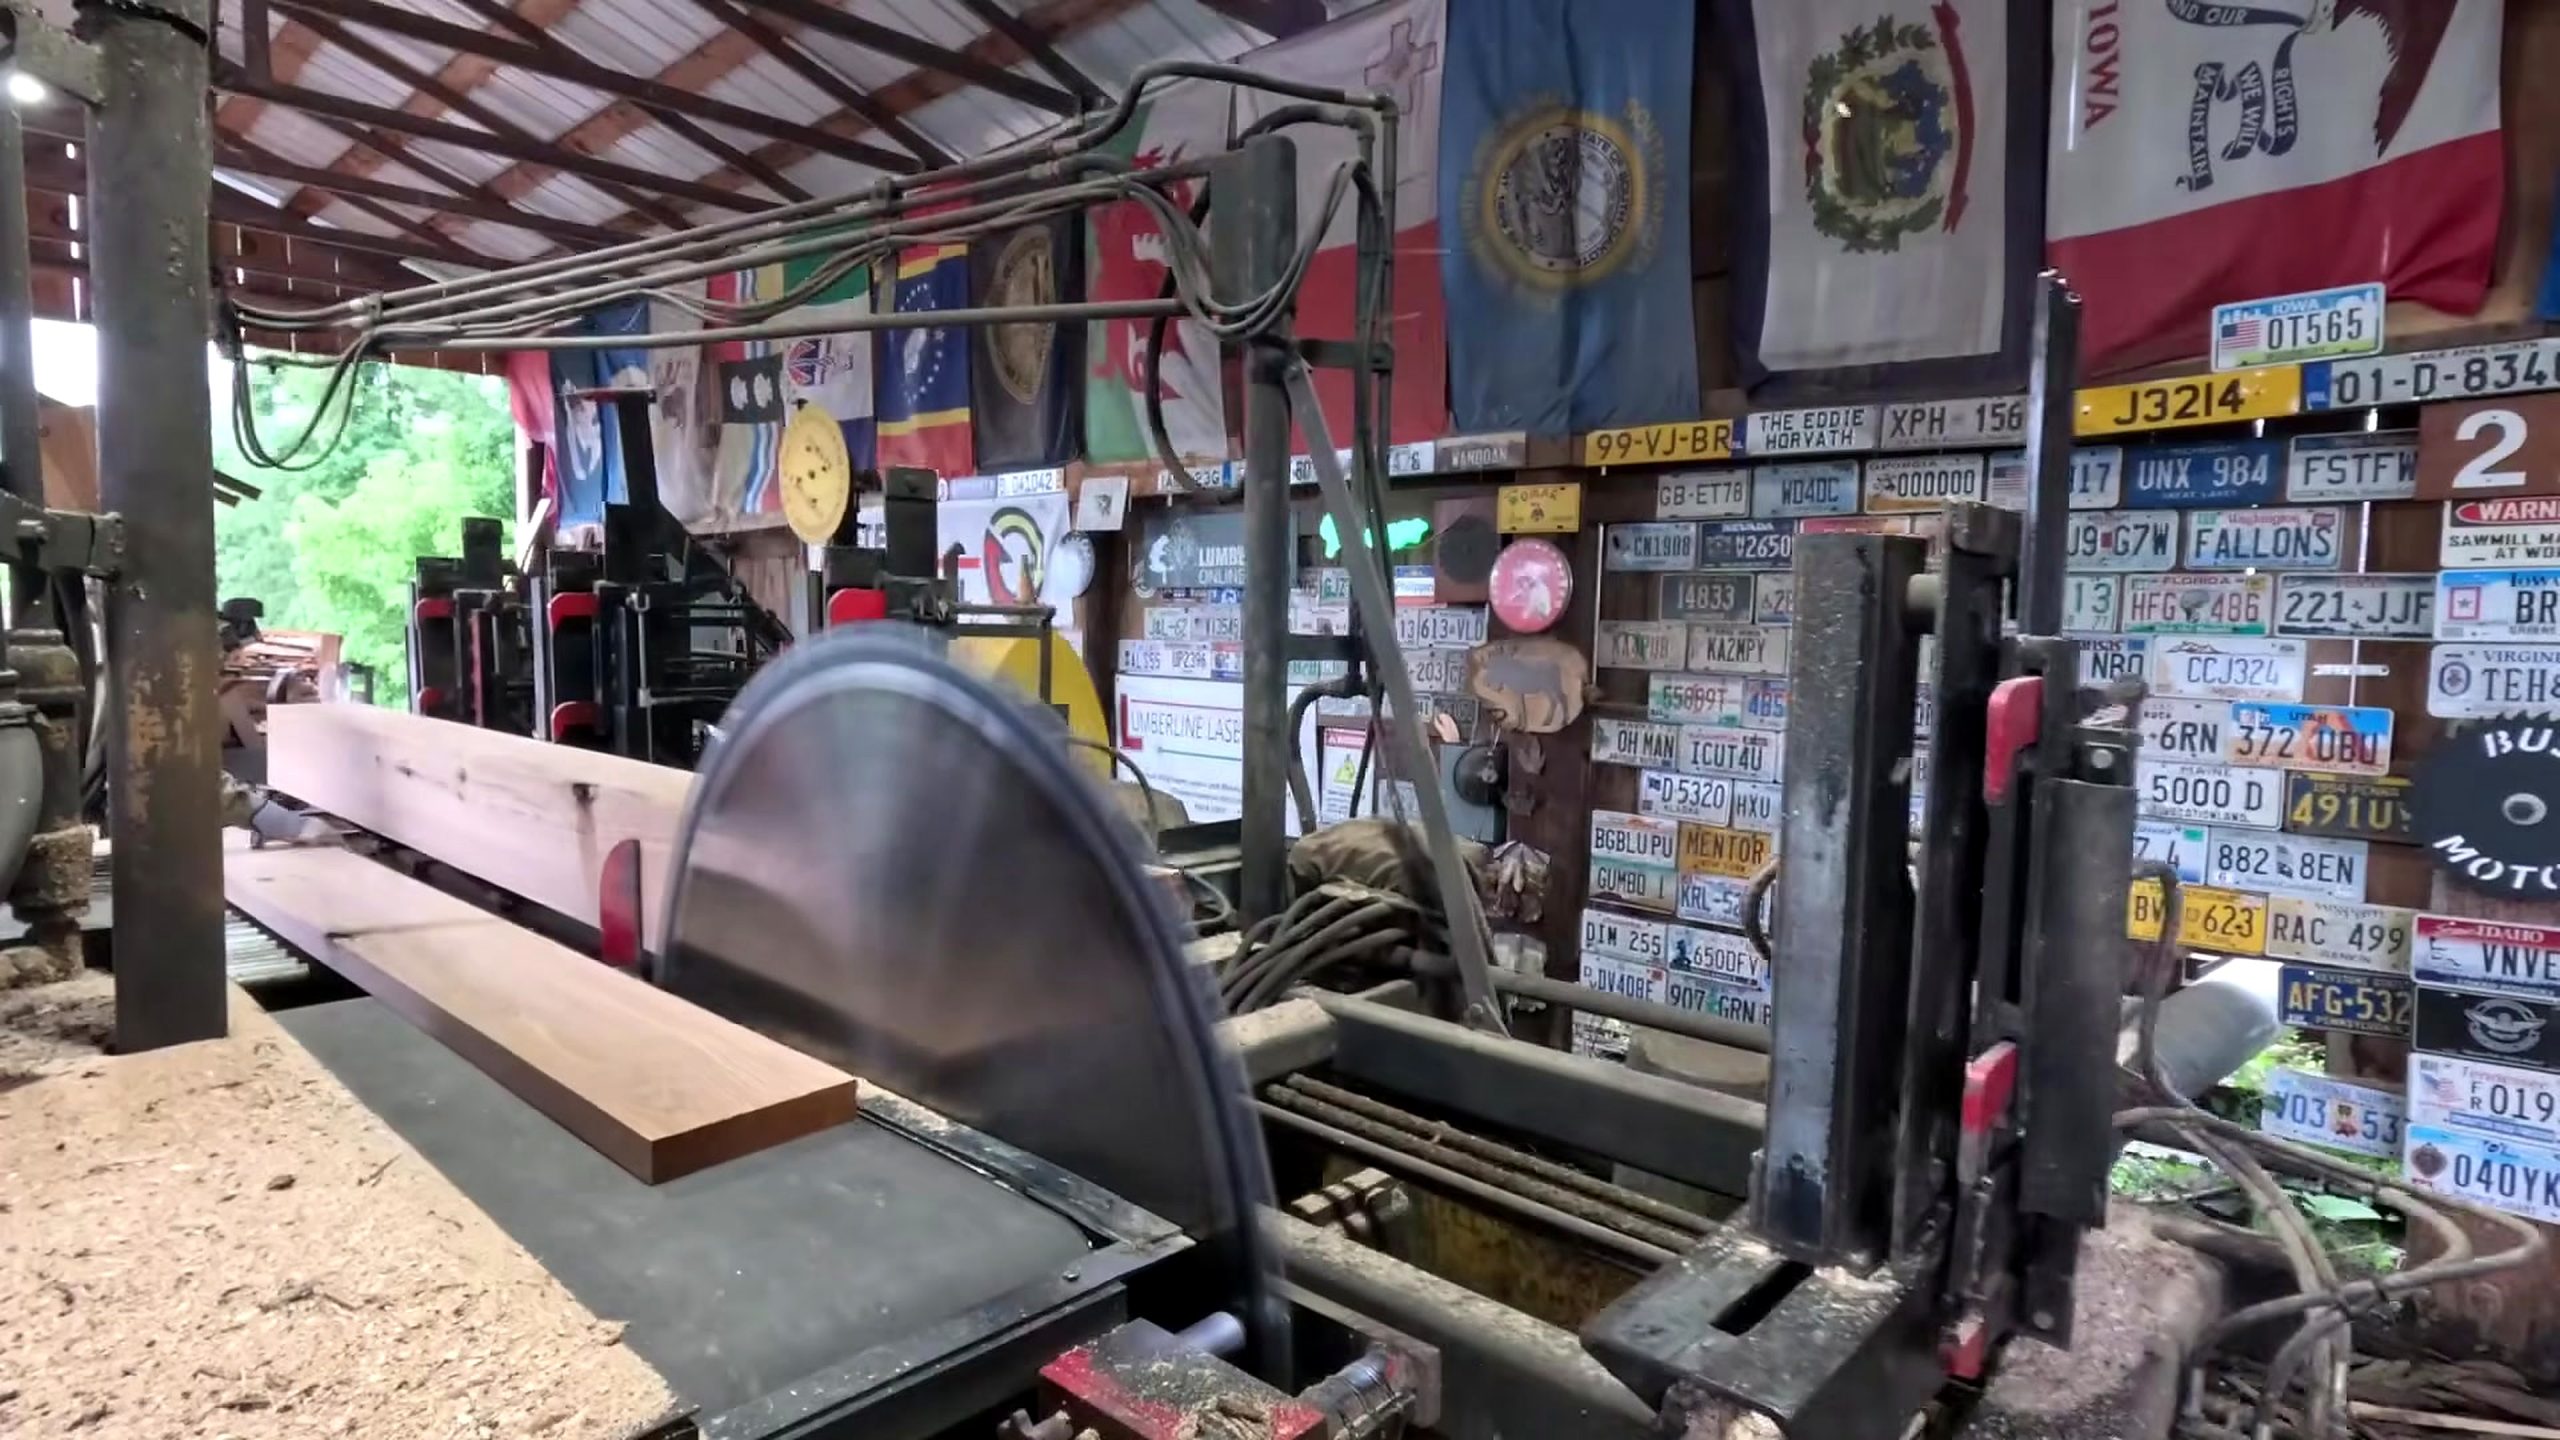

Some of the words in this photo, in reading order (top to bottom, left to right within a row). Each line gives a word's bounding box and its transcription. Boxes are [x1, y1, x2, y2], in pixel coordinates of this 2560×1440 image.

[2205, 8, 2248, 25] OUR
[2239, 68, 2262, 98] WE
[2274, 67, 2296, 137] RIGHTS
[2191, 65, 2217, 176] MAINTAIN
[2236, 106, 2262, 150] WILL
[2272, 297, 2320, 316] IOWA
[1760, 414, 1794, 432] THE
[1804, 408, 1864, 428] EDDIE
[1890, 406, 1947, 438] XPH
[1597, 424, 1730, 460] 99-VJ-BR
[1766, 429, 1856, 450] HORVATH
[2452, 409, 2527, 488] 2
[2138, 458, 2191, 491] UNX
[2212, 454, 2269, 487] 984
[2114, 523, 2169, 556] G7W
[2195, 526, 2333, 559] FALLONS
[2450, 533, 2531, 548] SAWMILL
[2495, 547, 2516, 560] AT
[2131, 592, 2176, 622] HFG
[2284, 591, 2347, 624] 221
[2367, 591, 2435, 625] JJF
[2187, 656, 2280, 686] CCJ324
[1643, 733, 1675, 759] MAN
[1691, 741, 1764, 772] ICUT4U
[2239, 725, 2295, 759] 372
[2153, 775, 2231, 808] 5000
[2245, 781, 2263, 811] D
[1687, 831, 1764, 864] MENTOR
[2218, 844, 2270, 876] 882
[2300, 852, 2355, 885] 8EN
[2203, 904, 2255, 939] 623
[2273, 912, 2328, 947] RAC
[2347, 922, 2405, 956] 499
[2475, 924, 2545, 944] IDAHO
[2288, 980, 2412, 1026] AFG-532
